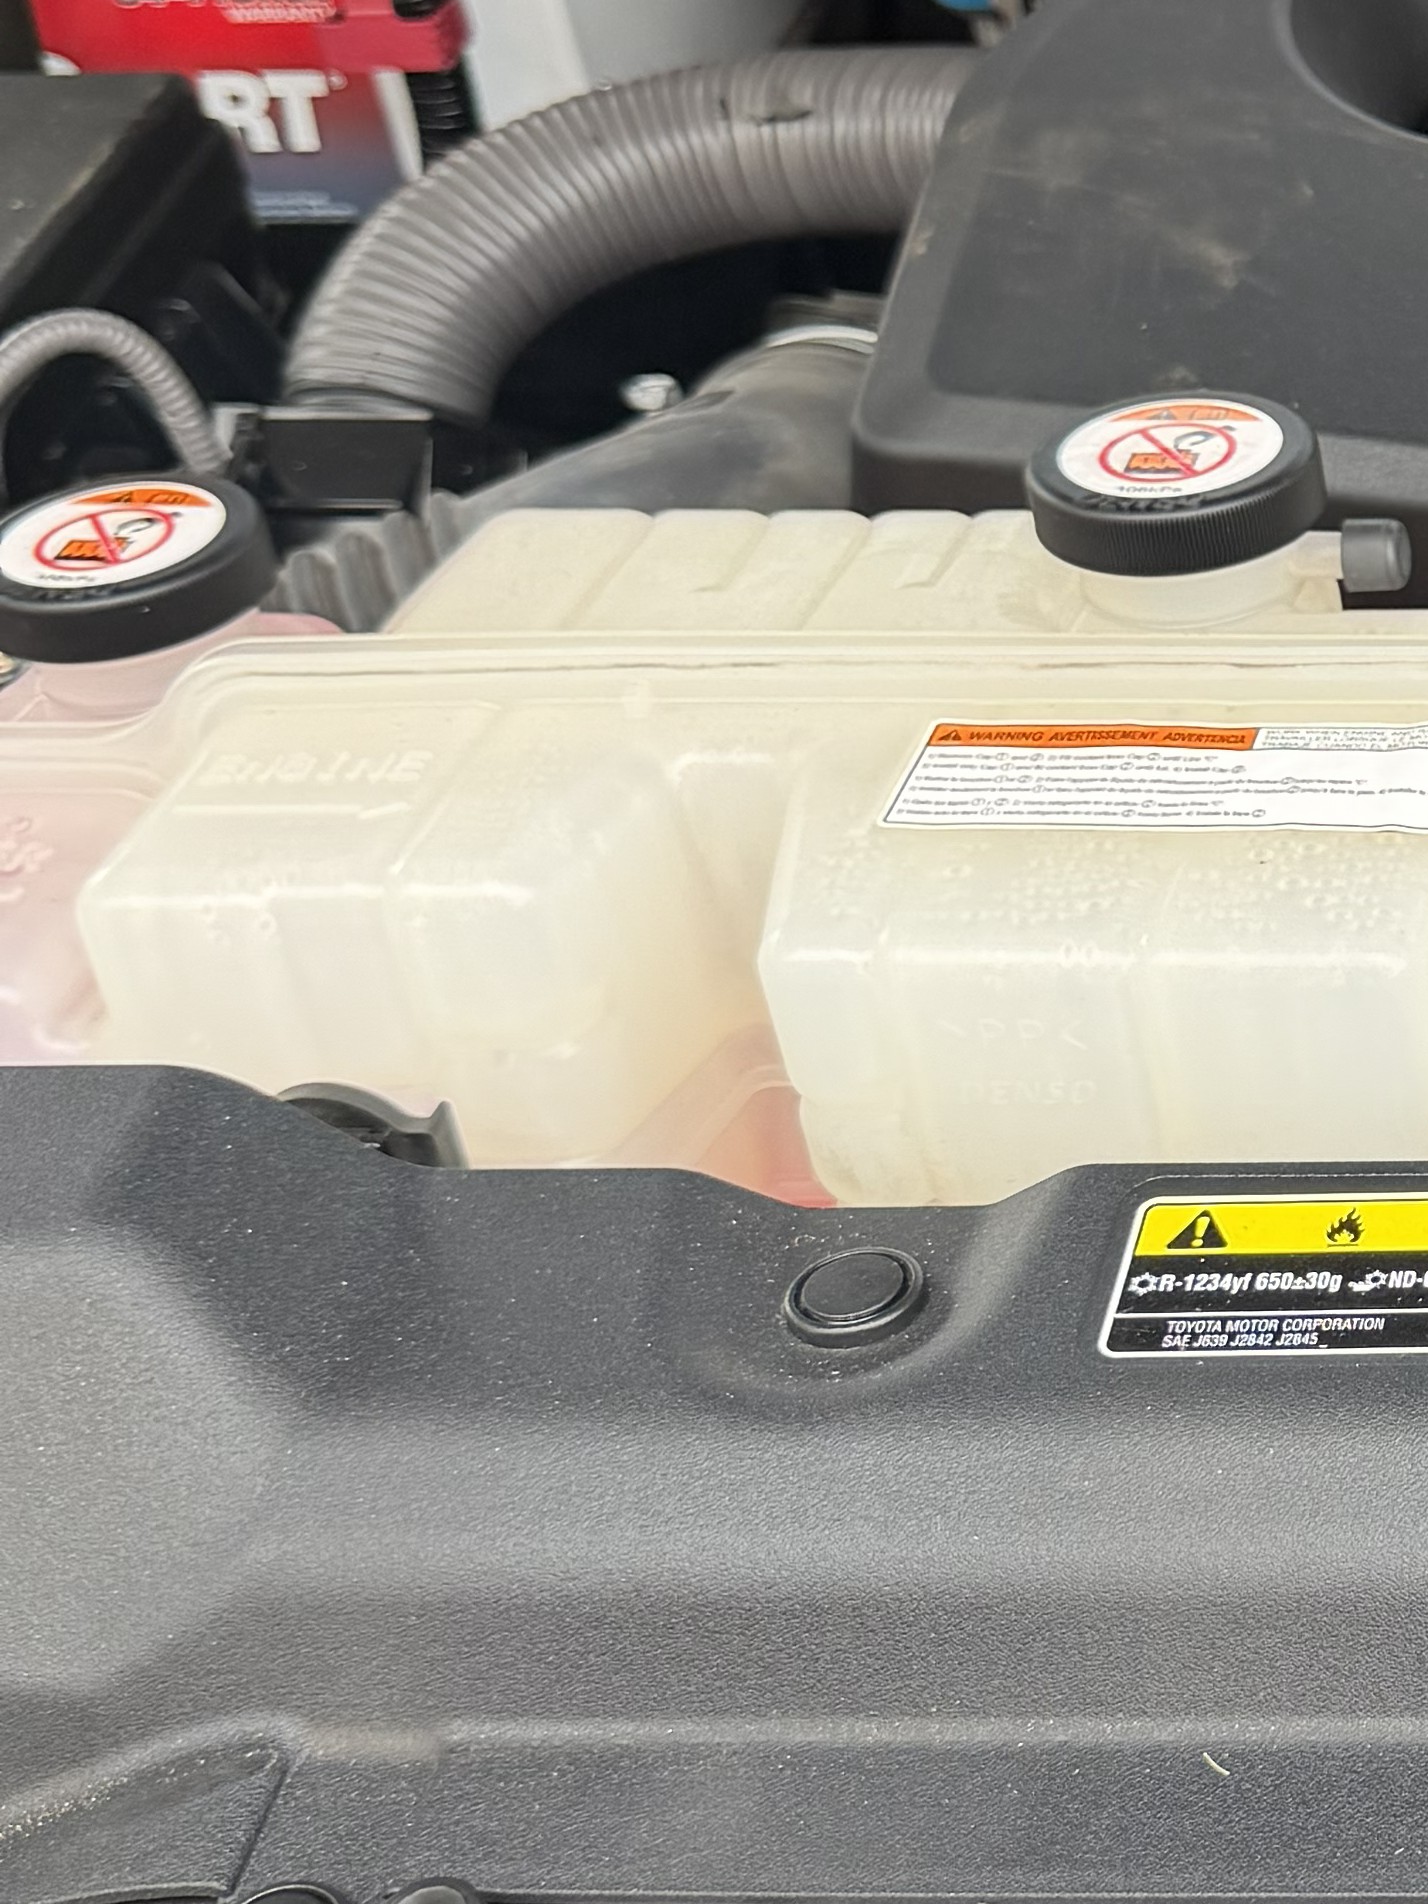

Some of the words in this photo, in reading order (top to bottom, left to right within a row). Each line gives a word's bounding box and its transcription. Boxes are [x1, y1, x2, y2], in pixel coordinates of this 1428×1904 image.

[968, 729, 1044, 743] WARNING
[1049, 729, 1158, 744] AVERTISSEMENT
[200, 751, 434, 786] ENGINE
[1158, 1272, 1253, 1295] R-1234yf
[1254, 1271, 1343, 1293] 650±30g
[1166, 1319, 1223, 1334] TOYOTA
[1225, 1318, 1280, 1333] MOTOR
[1282, 1317, 1386, 1332] CORPORATION
[1161, 1334, 1191, 1347] SAE
[1192, 1333, 1229, 1347] J639
[1229, 1332, 1273, 1347] J2842
